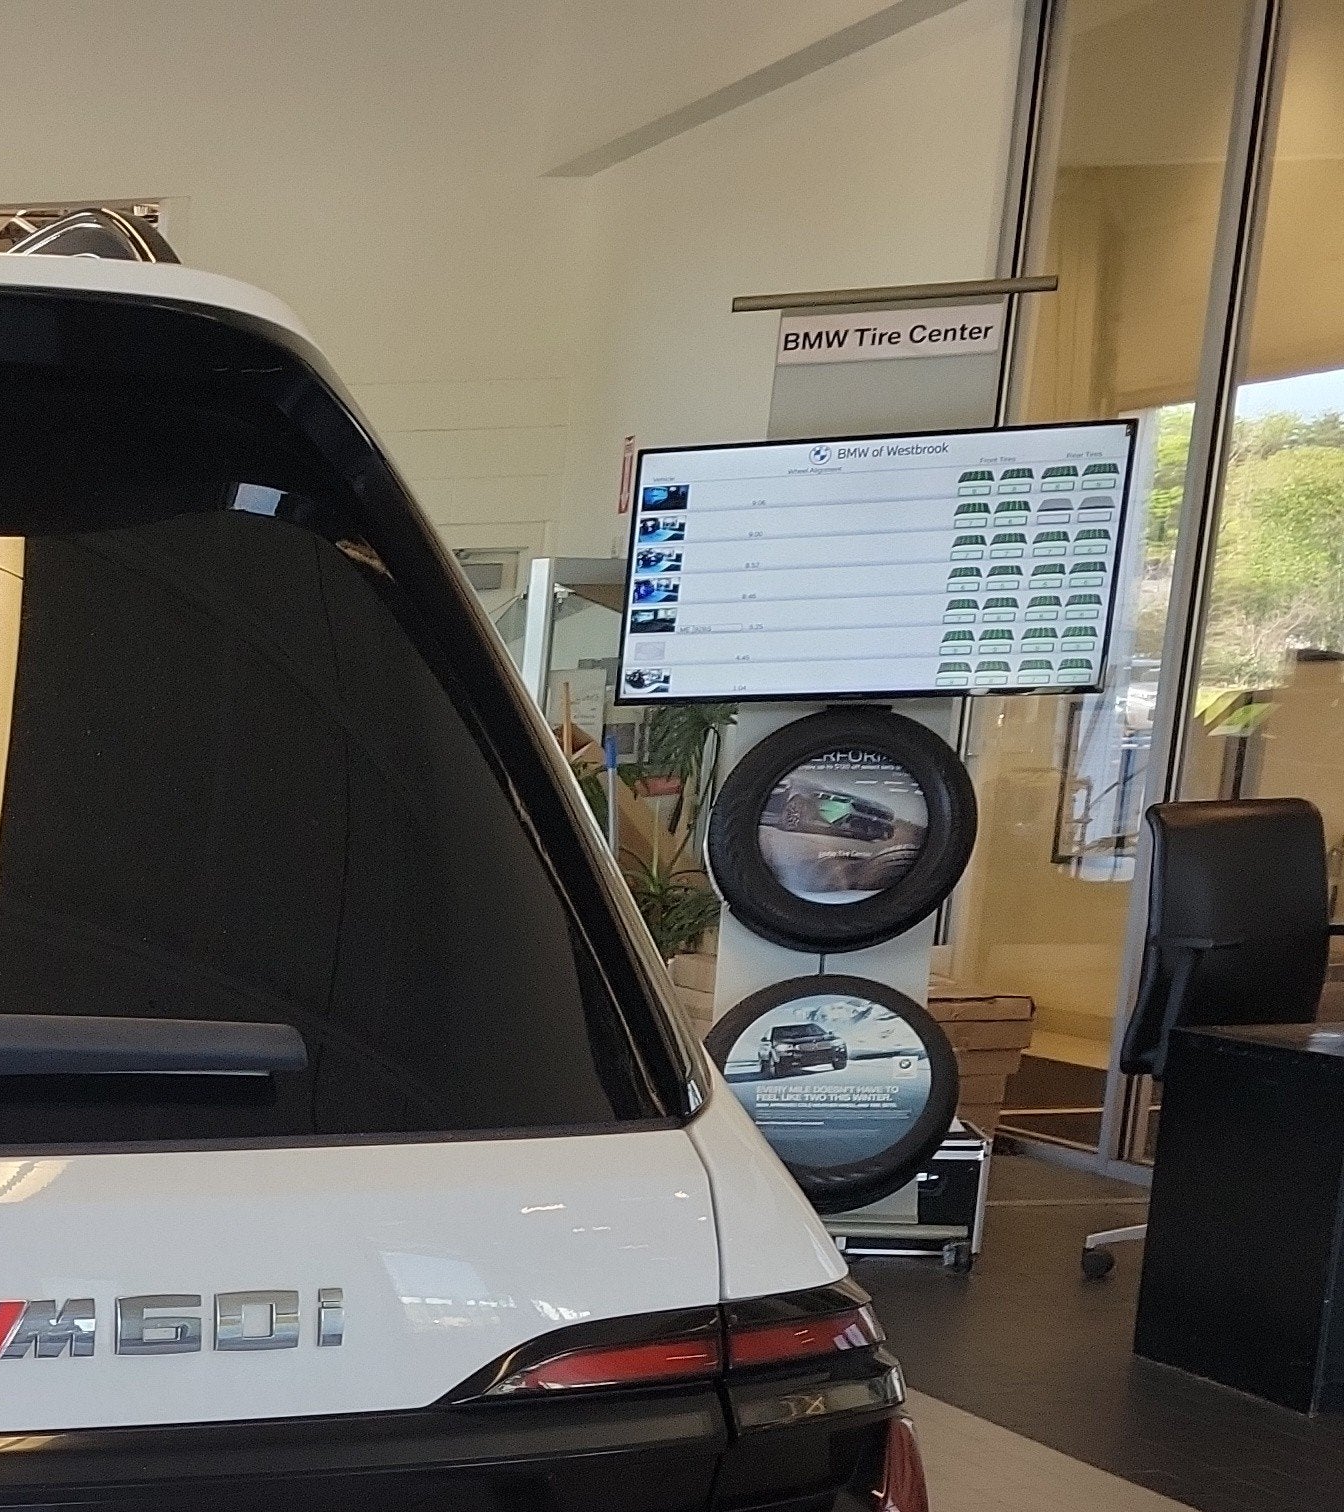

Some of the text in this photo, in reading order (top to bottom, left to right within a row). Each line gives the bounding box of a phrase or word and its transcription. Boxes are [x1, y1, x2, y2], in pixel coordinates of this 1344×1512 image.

[782, 323, 994, 352] BMW Tire Center
[837, 442, 950, 460] BMW of Westbrook
[883, 1085, 899, 1094] TO
[803, 1093, 827, 1102] TWO
